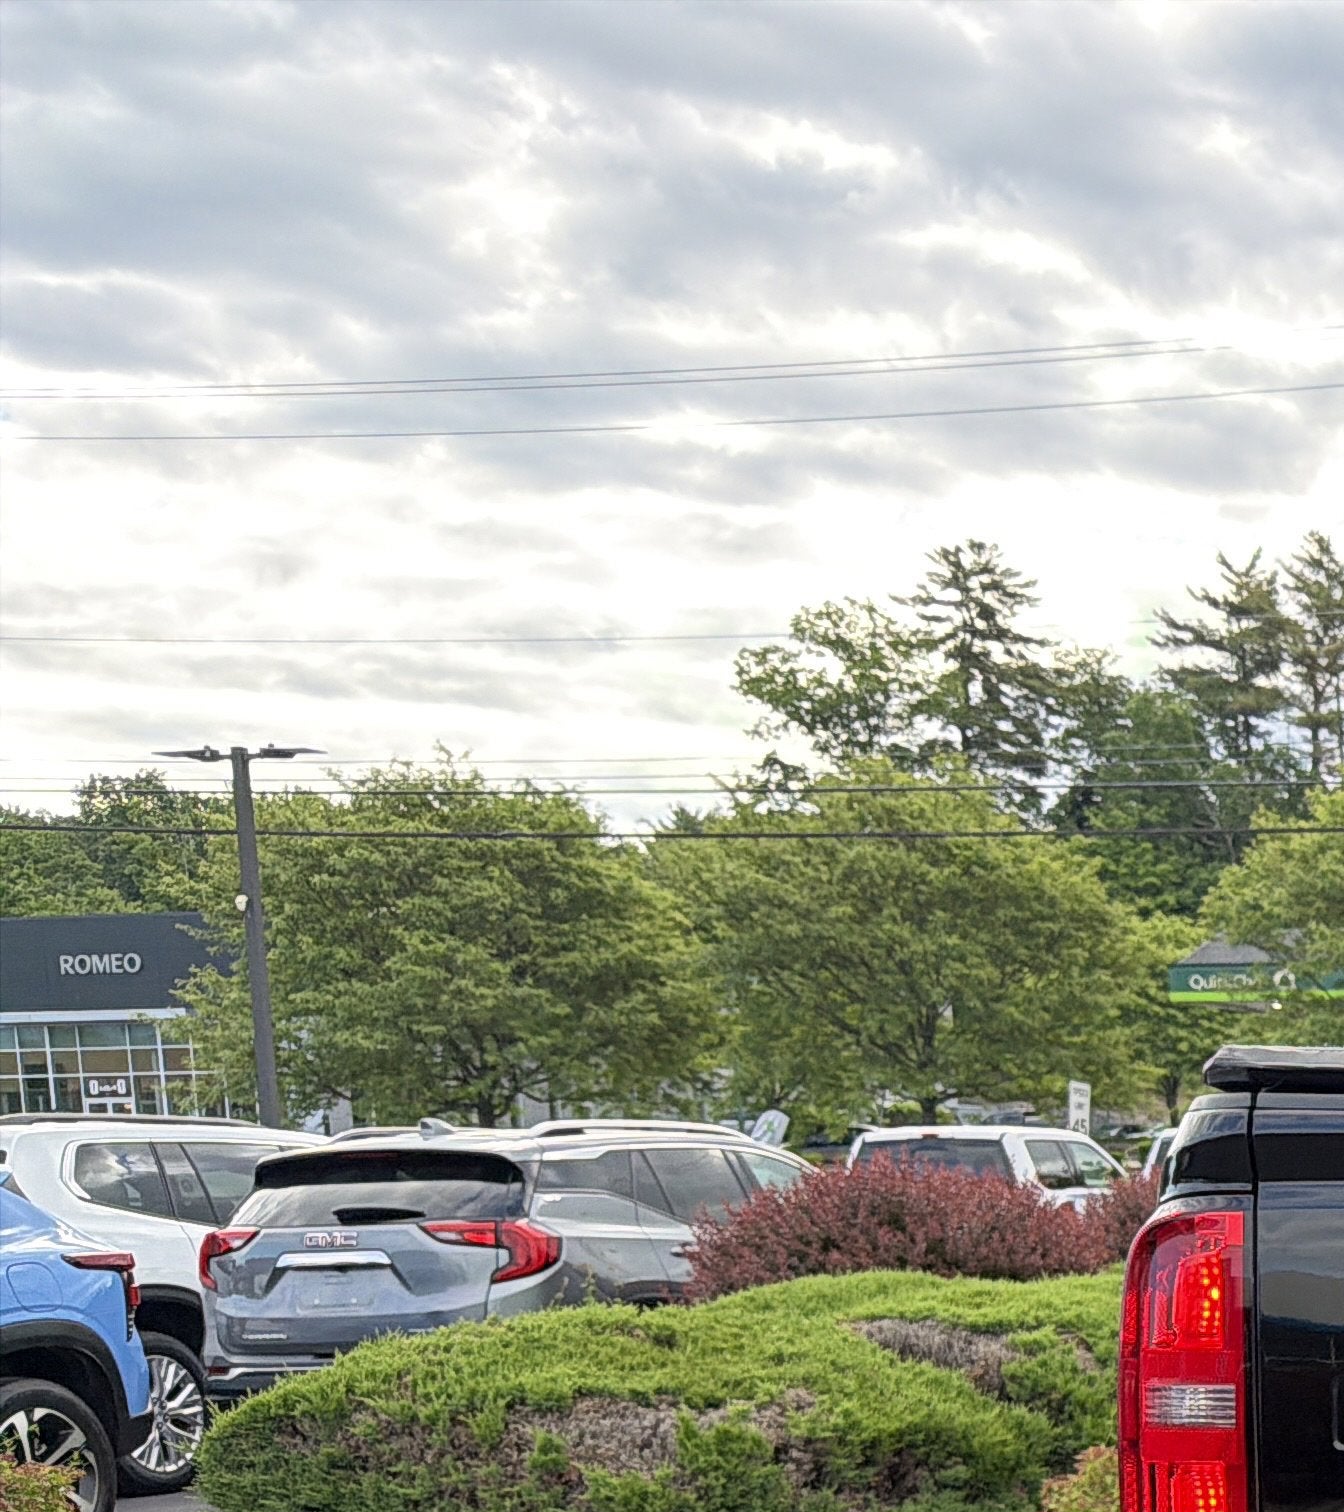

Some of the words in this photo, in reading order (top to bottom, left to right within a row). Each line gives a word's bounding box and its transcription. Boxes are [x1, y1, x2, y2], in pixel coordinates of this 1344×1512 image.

[59, 952, 142, 975] ROMEO
[1072, 1118, 1087, 1135] 45
[304, 1231, 358, 1248] GMC
